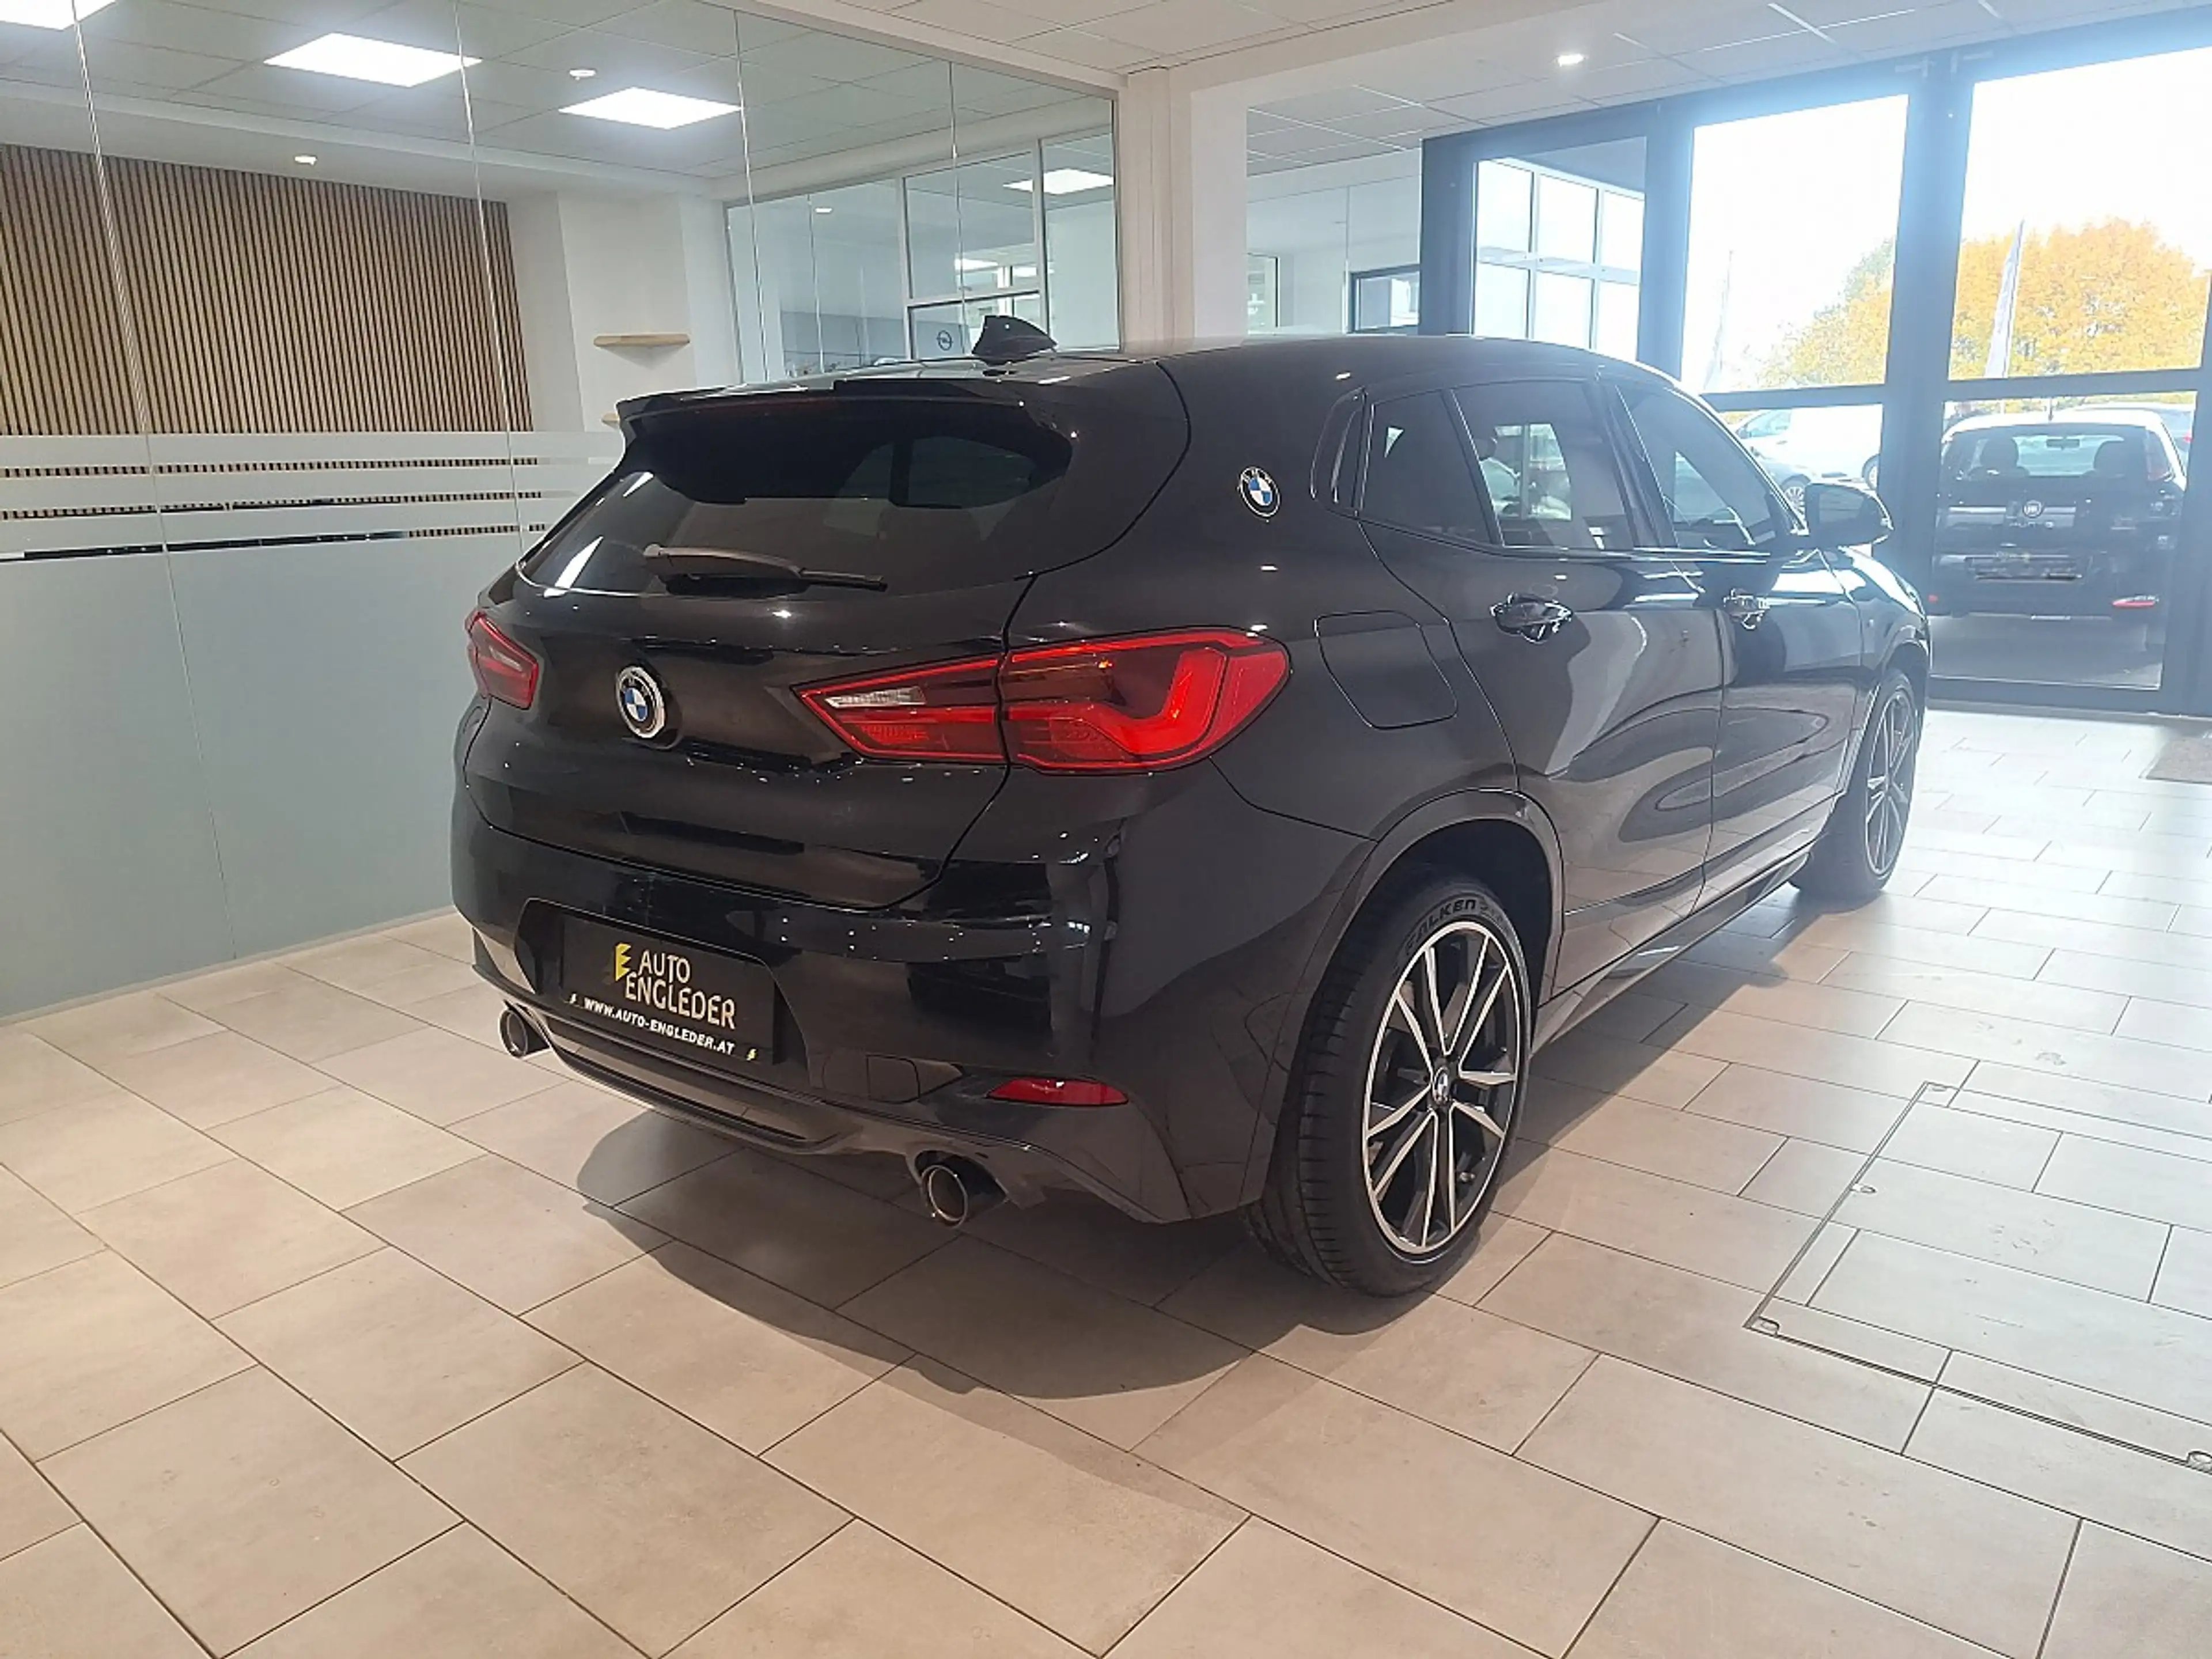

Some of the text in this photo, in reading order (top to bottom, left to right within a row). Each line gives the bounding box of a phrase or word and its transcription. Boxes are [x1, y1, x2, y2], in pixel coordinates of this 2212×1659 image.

[638, 949, 691, 984] AUTO
[584, 997, 735, 1056] WWW.AUTO-ENGLEDER.AT
[625, 971, 736, 1030] ENGLEDER
